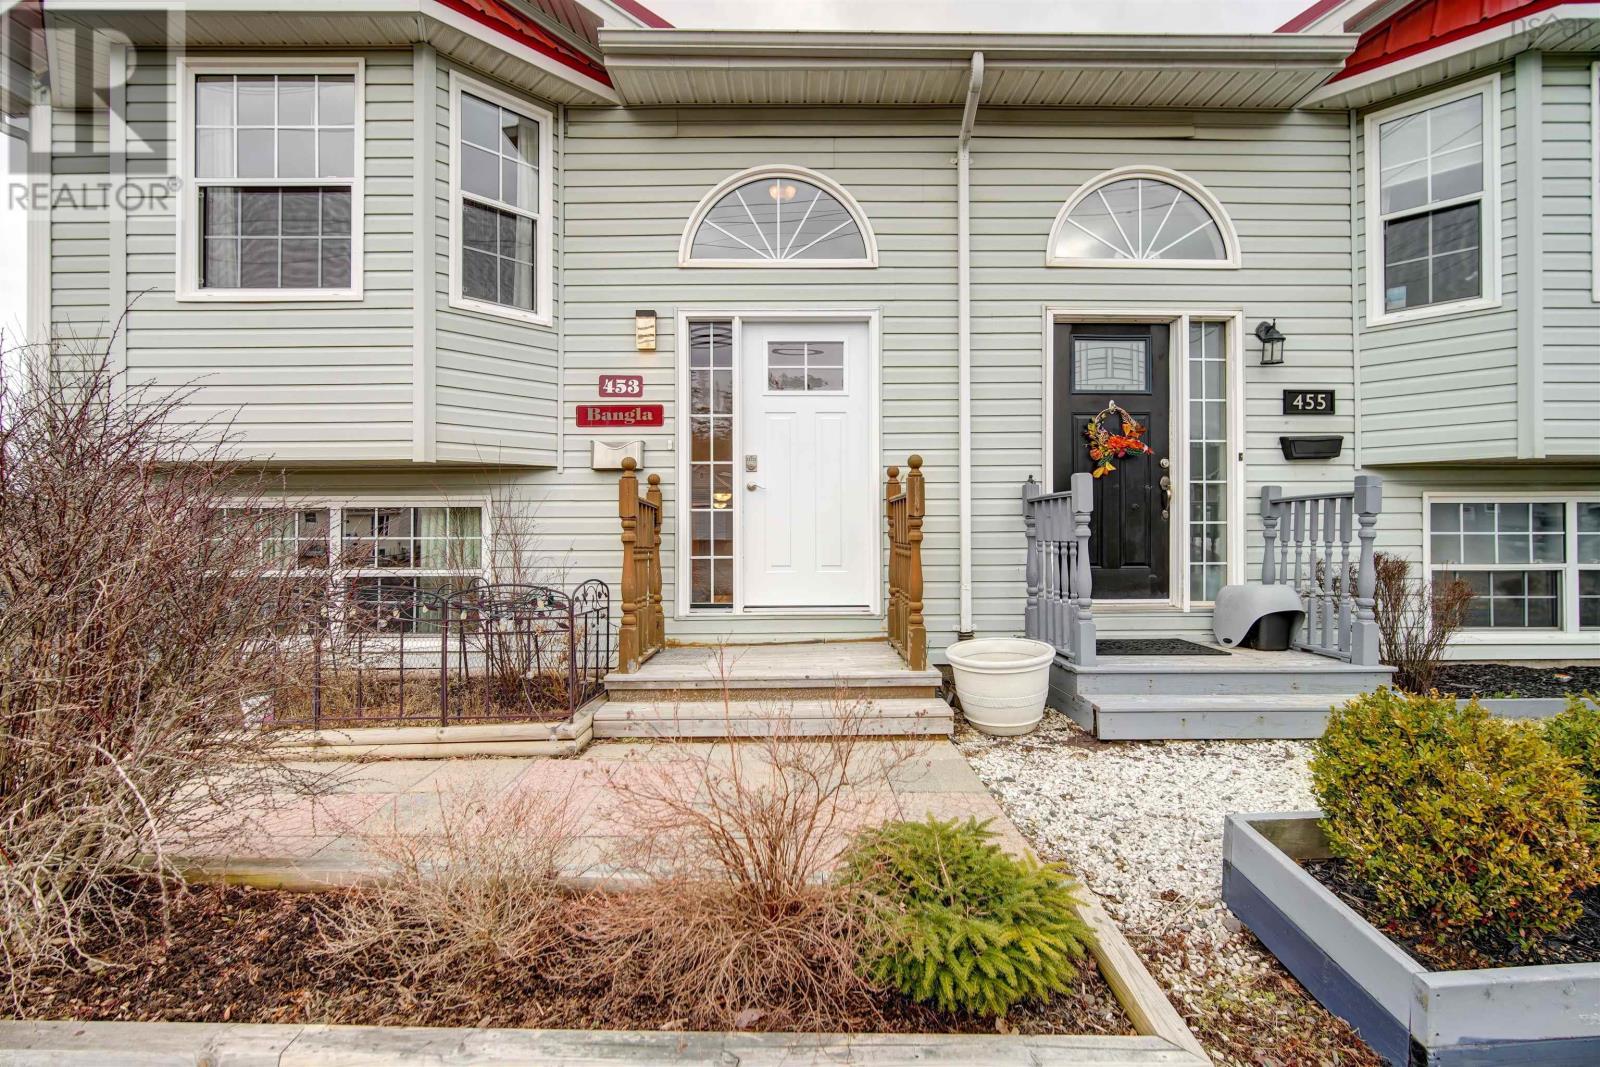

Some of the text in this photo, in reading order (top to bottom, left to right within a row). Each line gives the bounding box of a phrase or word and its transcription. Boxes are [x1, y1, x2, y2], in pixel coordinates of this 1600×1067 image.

[602, 379, 640, 394] 453
[1292, 394, 1326, 410] 455
[586, 407, 654, 424] Bangla
